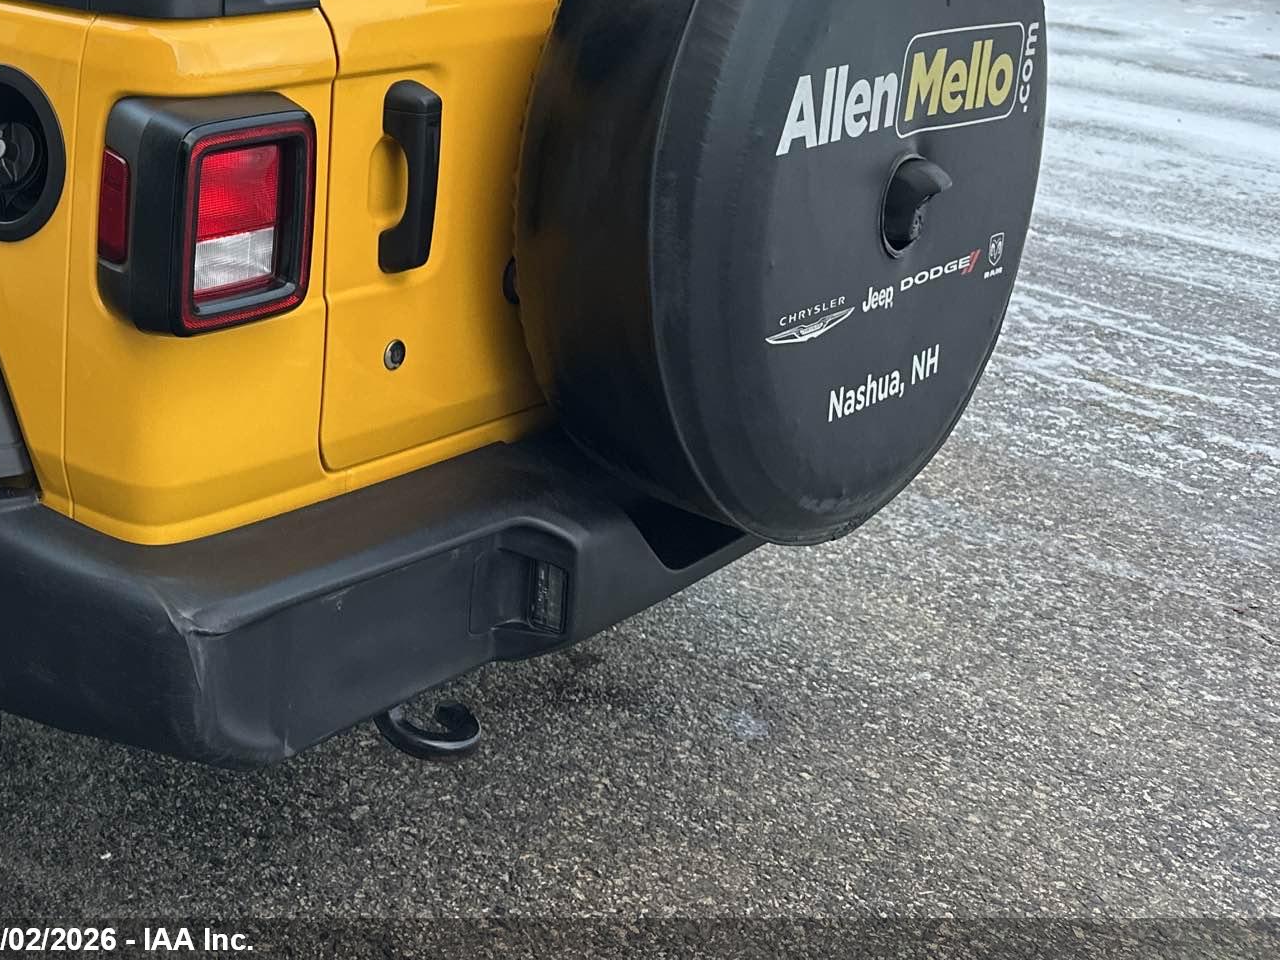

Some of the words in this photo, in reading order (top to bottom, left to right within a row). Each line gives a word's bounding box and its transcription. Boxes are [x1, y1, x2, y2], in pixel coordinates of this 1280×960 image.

[900, 254, 971, 292] DODGE
[983, 266, 1004, 280] RAM
[779, 295, 846, 327] CHRYSLER
[862, 285, 894, 313] Jeep
[828, 373, 905, 423] Nashua,
[911, 343, 940, 385] NH
